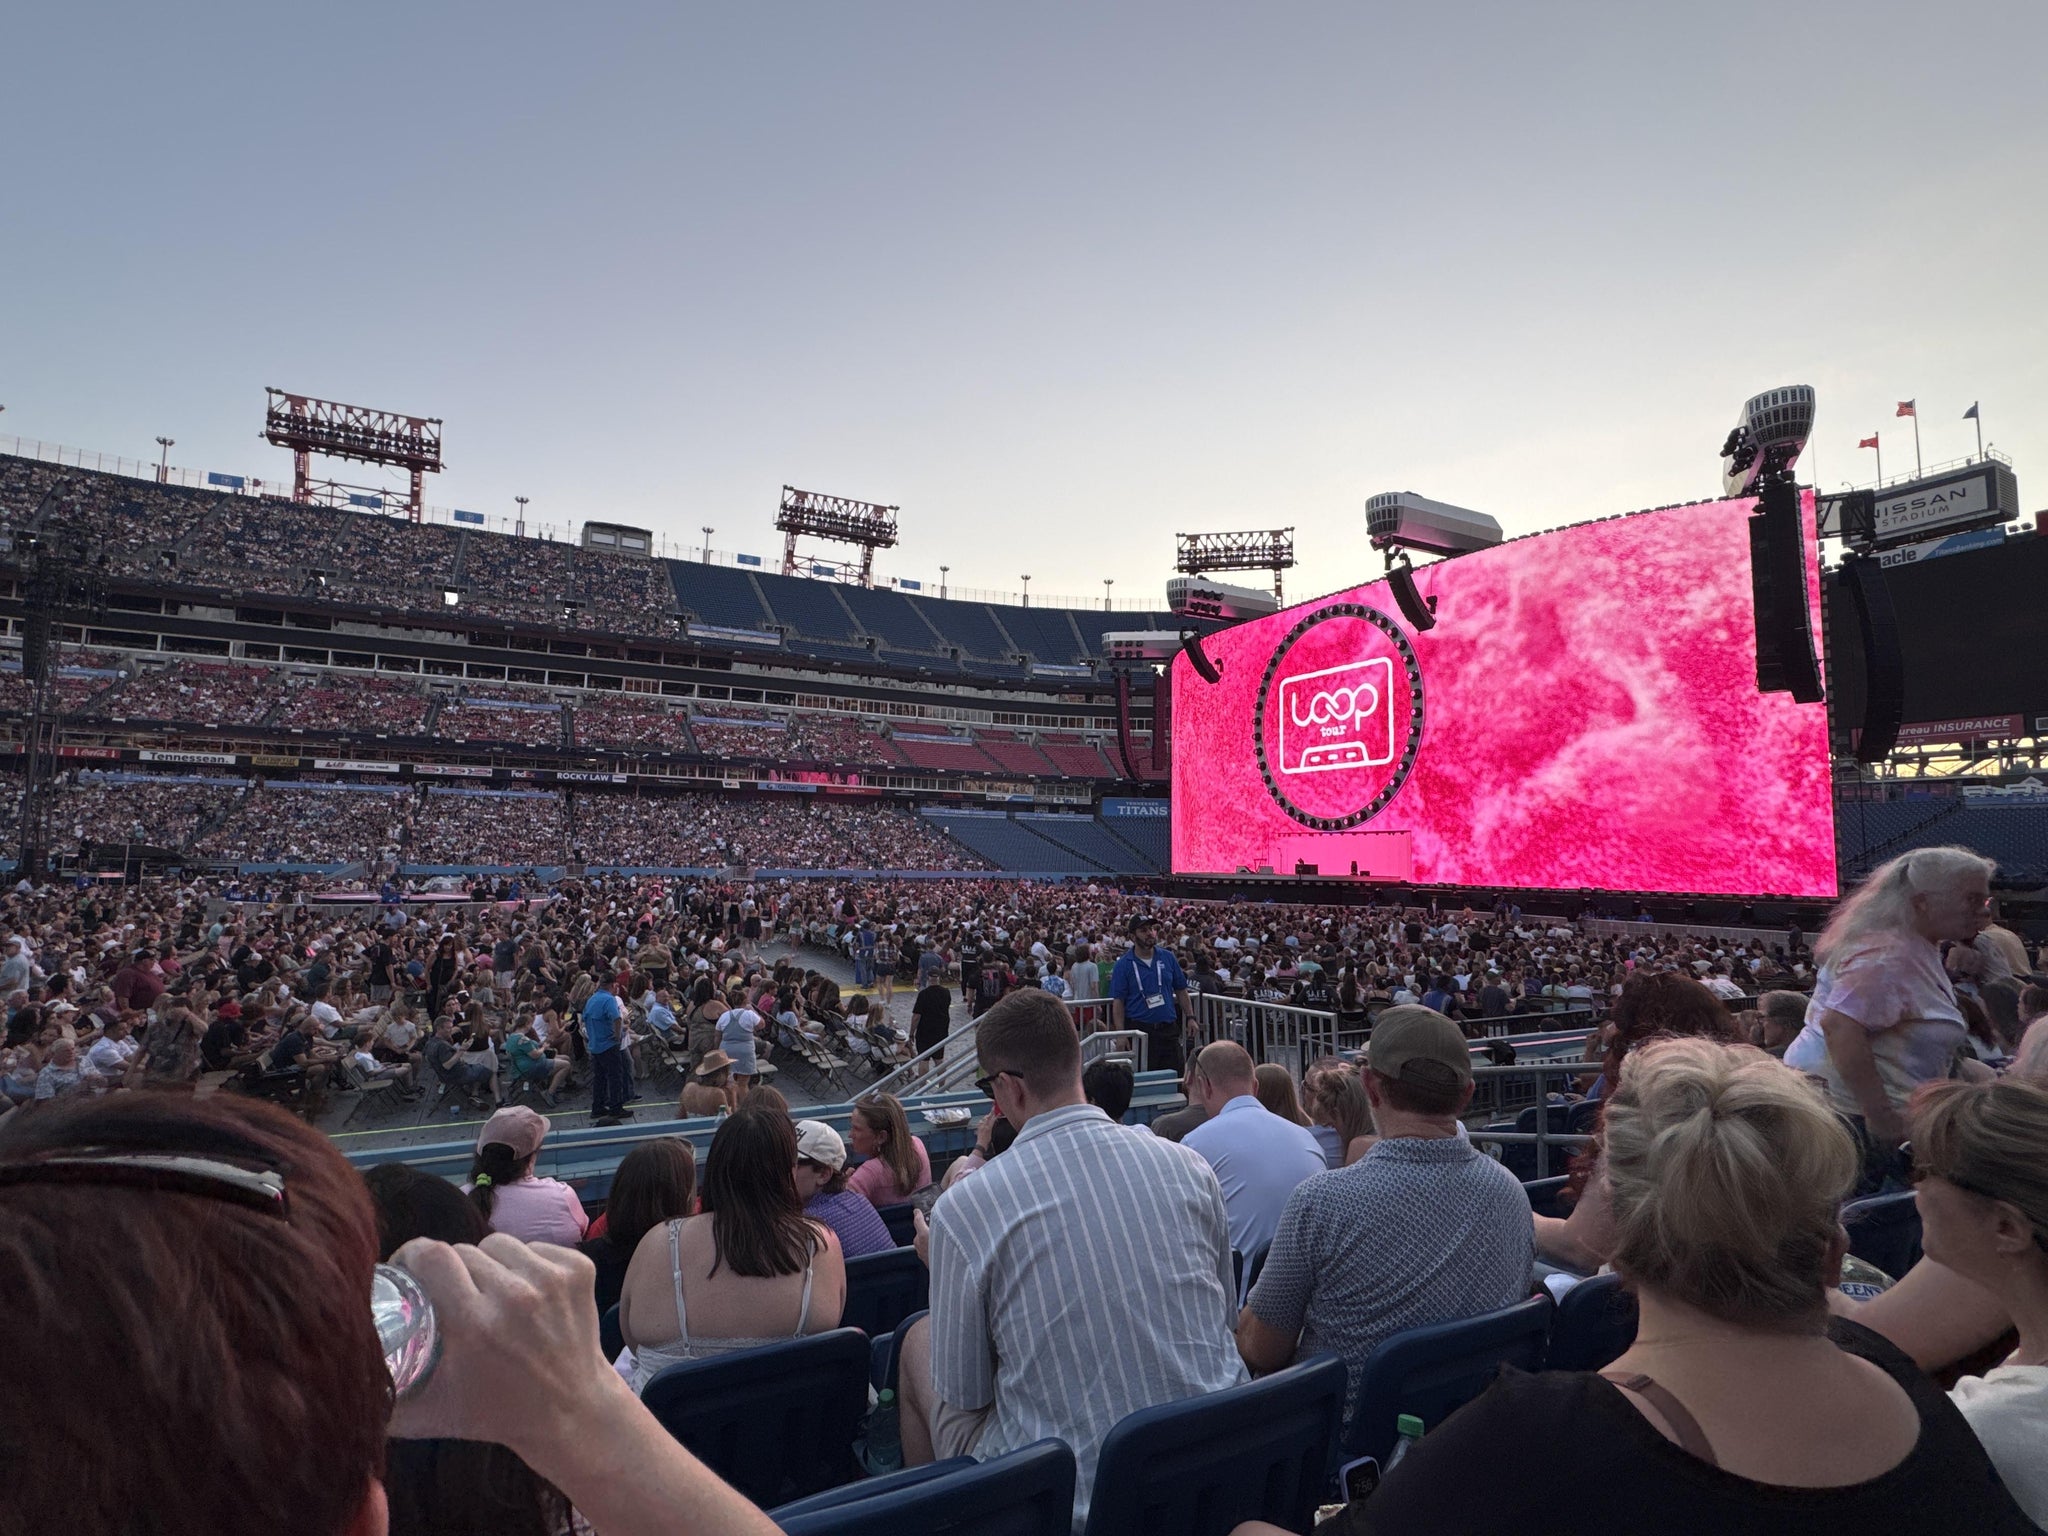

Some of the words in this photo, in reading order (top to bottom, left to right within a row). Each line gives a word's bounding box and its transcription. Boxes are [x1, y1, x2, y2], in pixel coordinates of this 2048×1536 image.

[1881, 504, 1950, 527] STADIUM
[1881, 548, 1917, 567] acle
[1320, 725, 1347, 737] tour
[1899, 726, 1930, 735] ureau
[1933, 718, 2011, 733] INSURANCE
[511, 769, 536, 779] FedEx
[556, 772, 587, 781] ROCKY
[589, 773, 609, 782] LAW
[777, 783, 809, 792] Gallagher
[1117, 805, 1168, 816] TITANS
